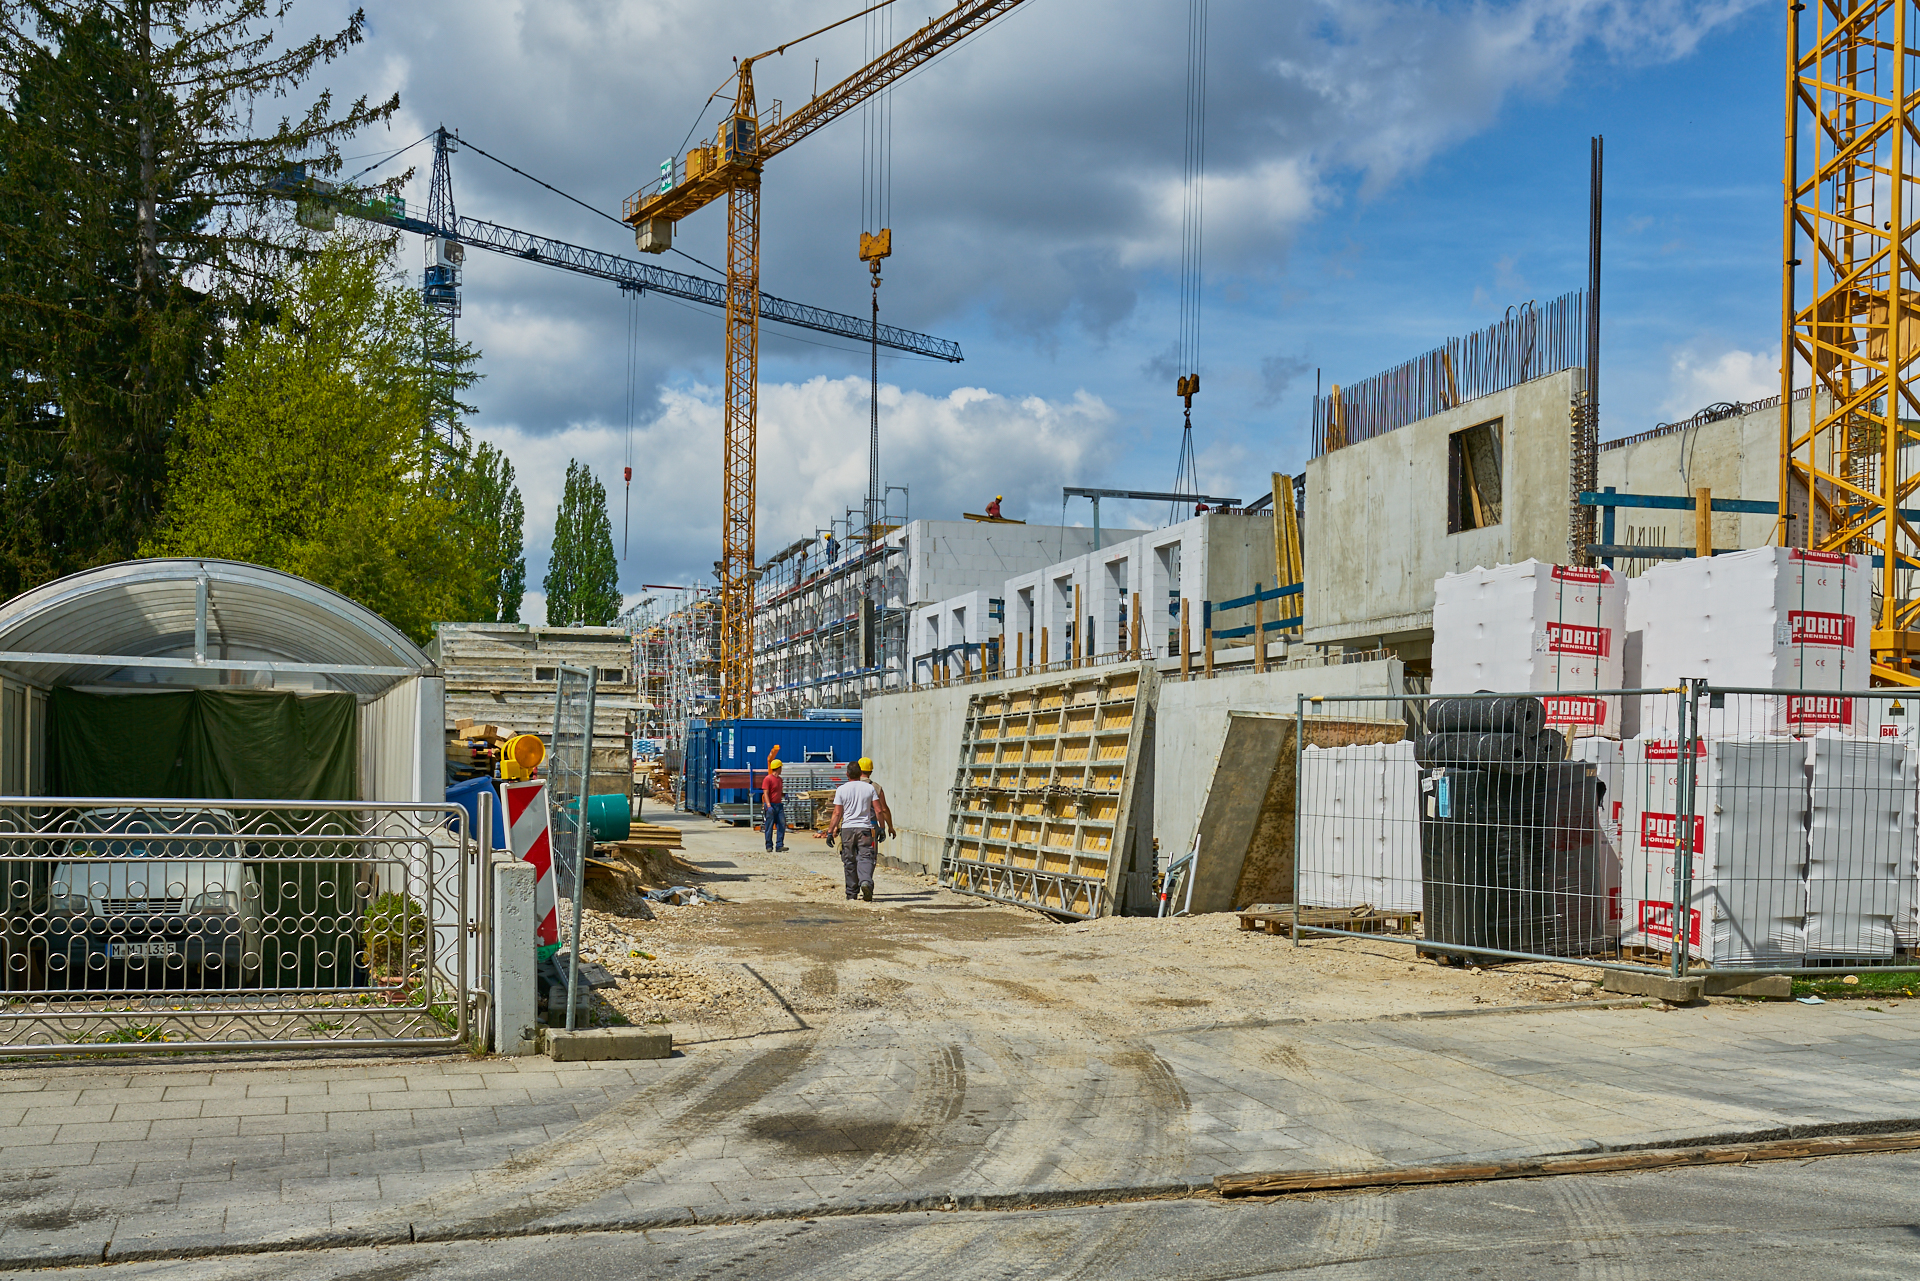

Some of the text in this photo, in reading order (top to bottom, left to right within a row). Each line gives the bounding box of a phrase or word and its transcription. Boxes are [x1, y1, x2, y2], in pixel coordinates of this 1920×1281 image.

[1798, 550, 1842, 559] RENBETO
[1792, 616, 1846, 635] PORIT
[1550, 627, 1600, 646] PORIT
[1792, 633, 1843, 641] PORENBETON
[1550, 643, 1598, 652] PORENBETON
[1548, 700, 1596, 716] PORIT
[1792, 696, 1844, 714] PORIT
[1882, 728, 1899, 736] BKL
[1645, 836, 1696, 846] PORENB
